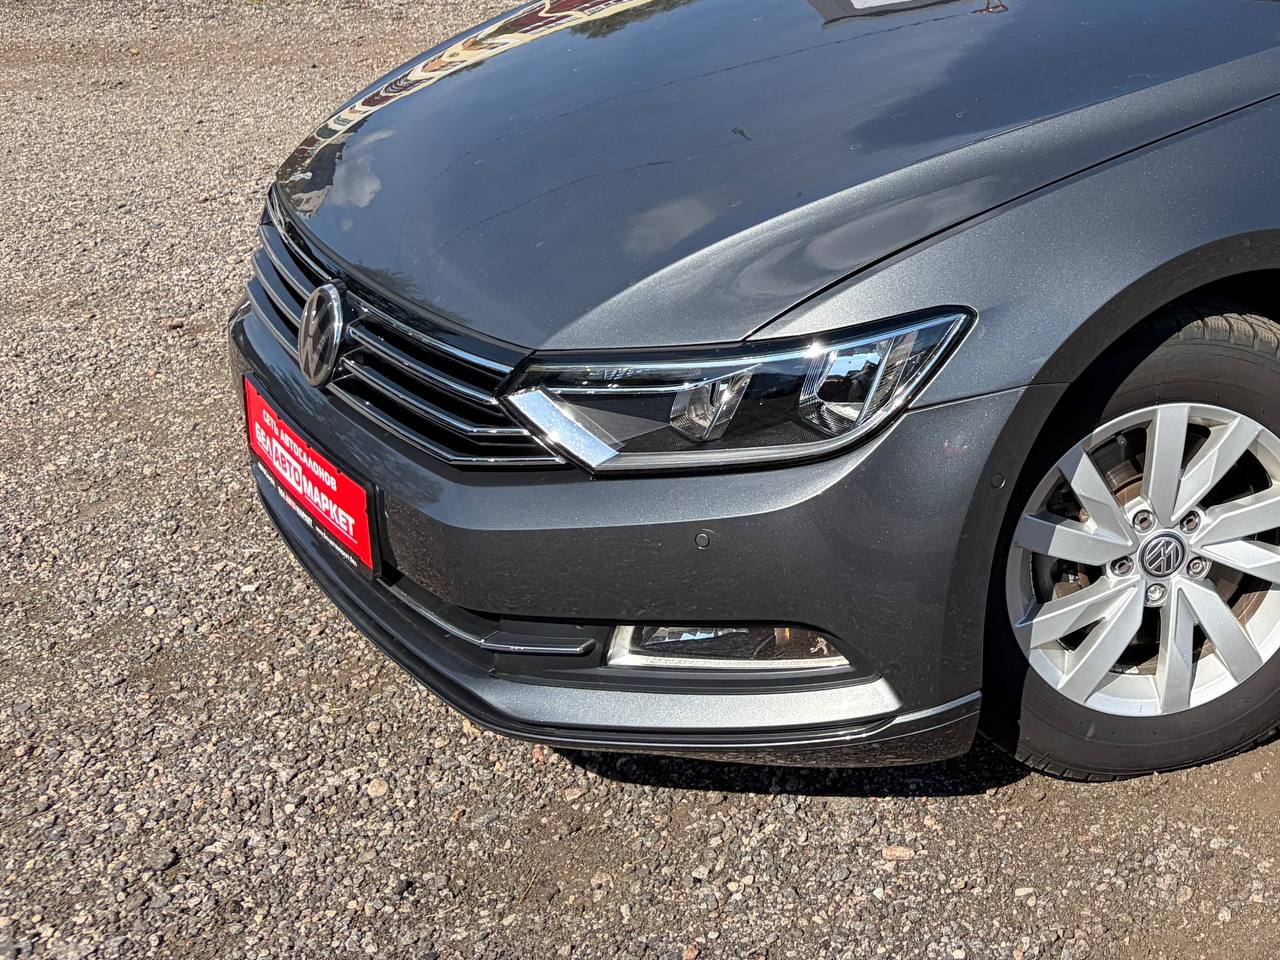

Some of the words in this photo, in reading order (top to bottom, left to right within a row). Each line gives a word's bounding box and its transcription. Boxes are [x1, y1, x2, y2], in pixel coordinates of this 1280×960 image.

[254, 421, 273, 459] БЕЛ
[272, 440, 303, 492] АВТО
[302, 474, 356, 537] МАРКЕТ
[262, 408, 279, 437] СЕТЬ
[280, 429, 337, 492] АВТОСАЛОНОВ
